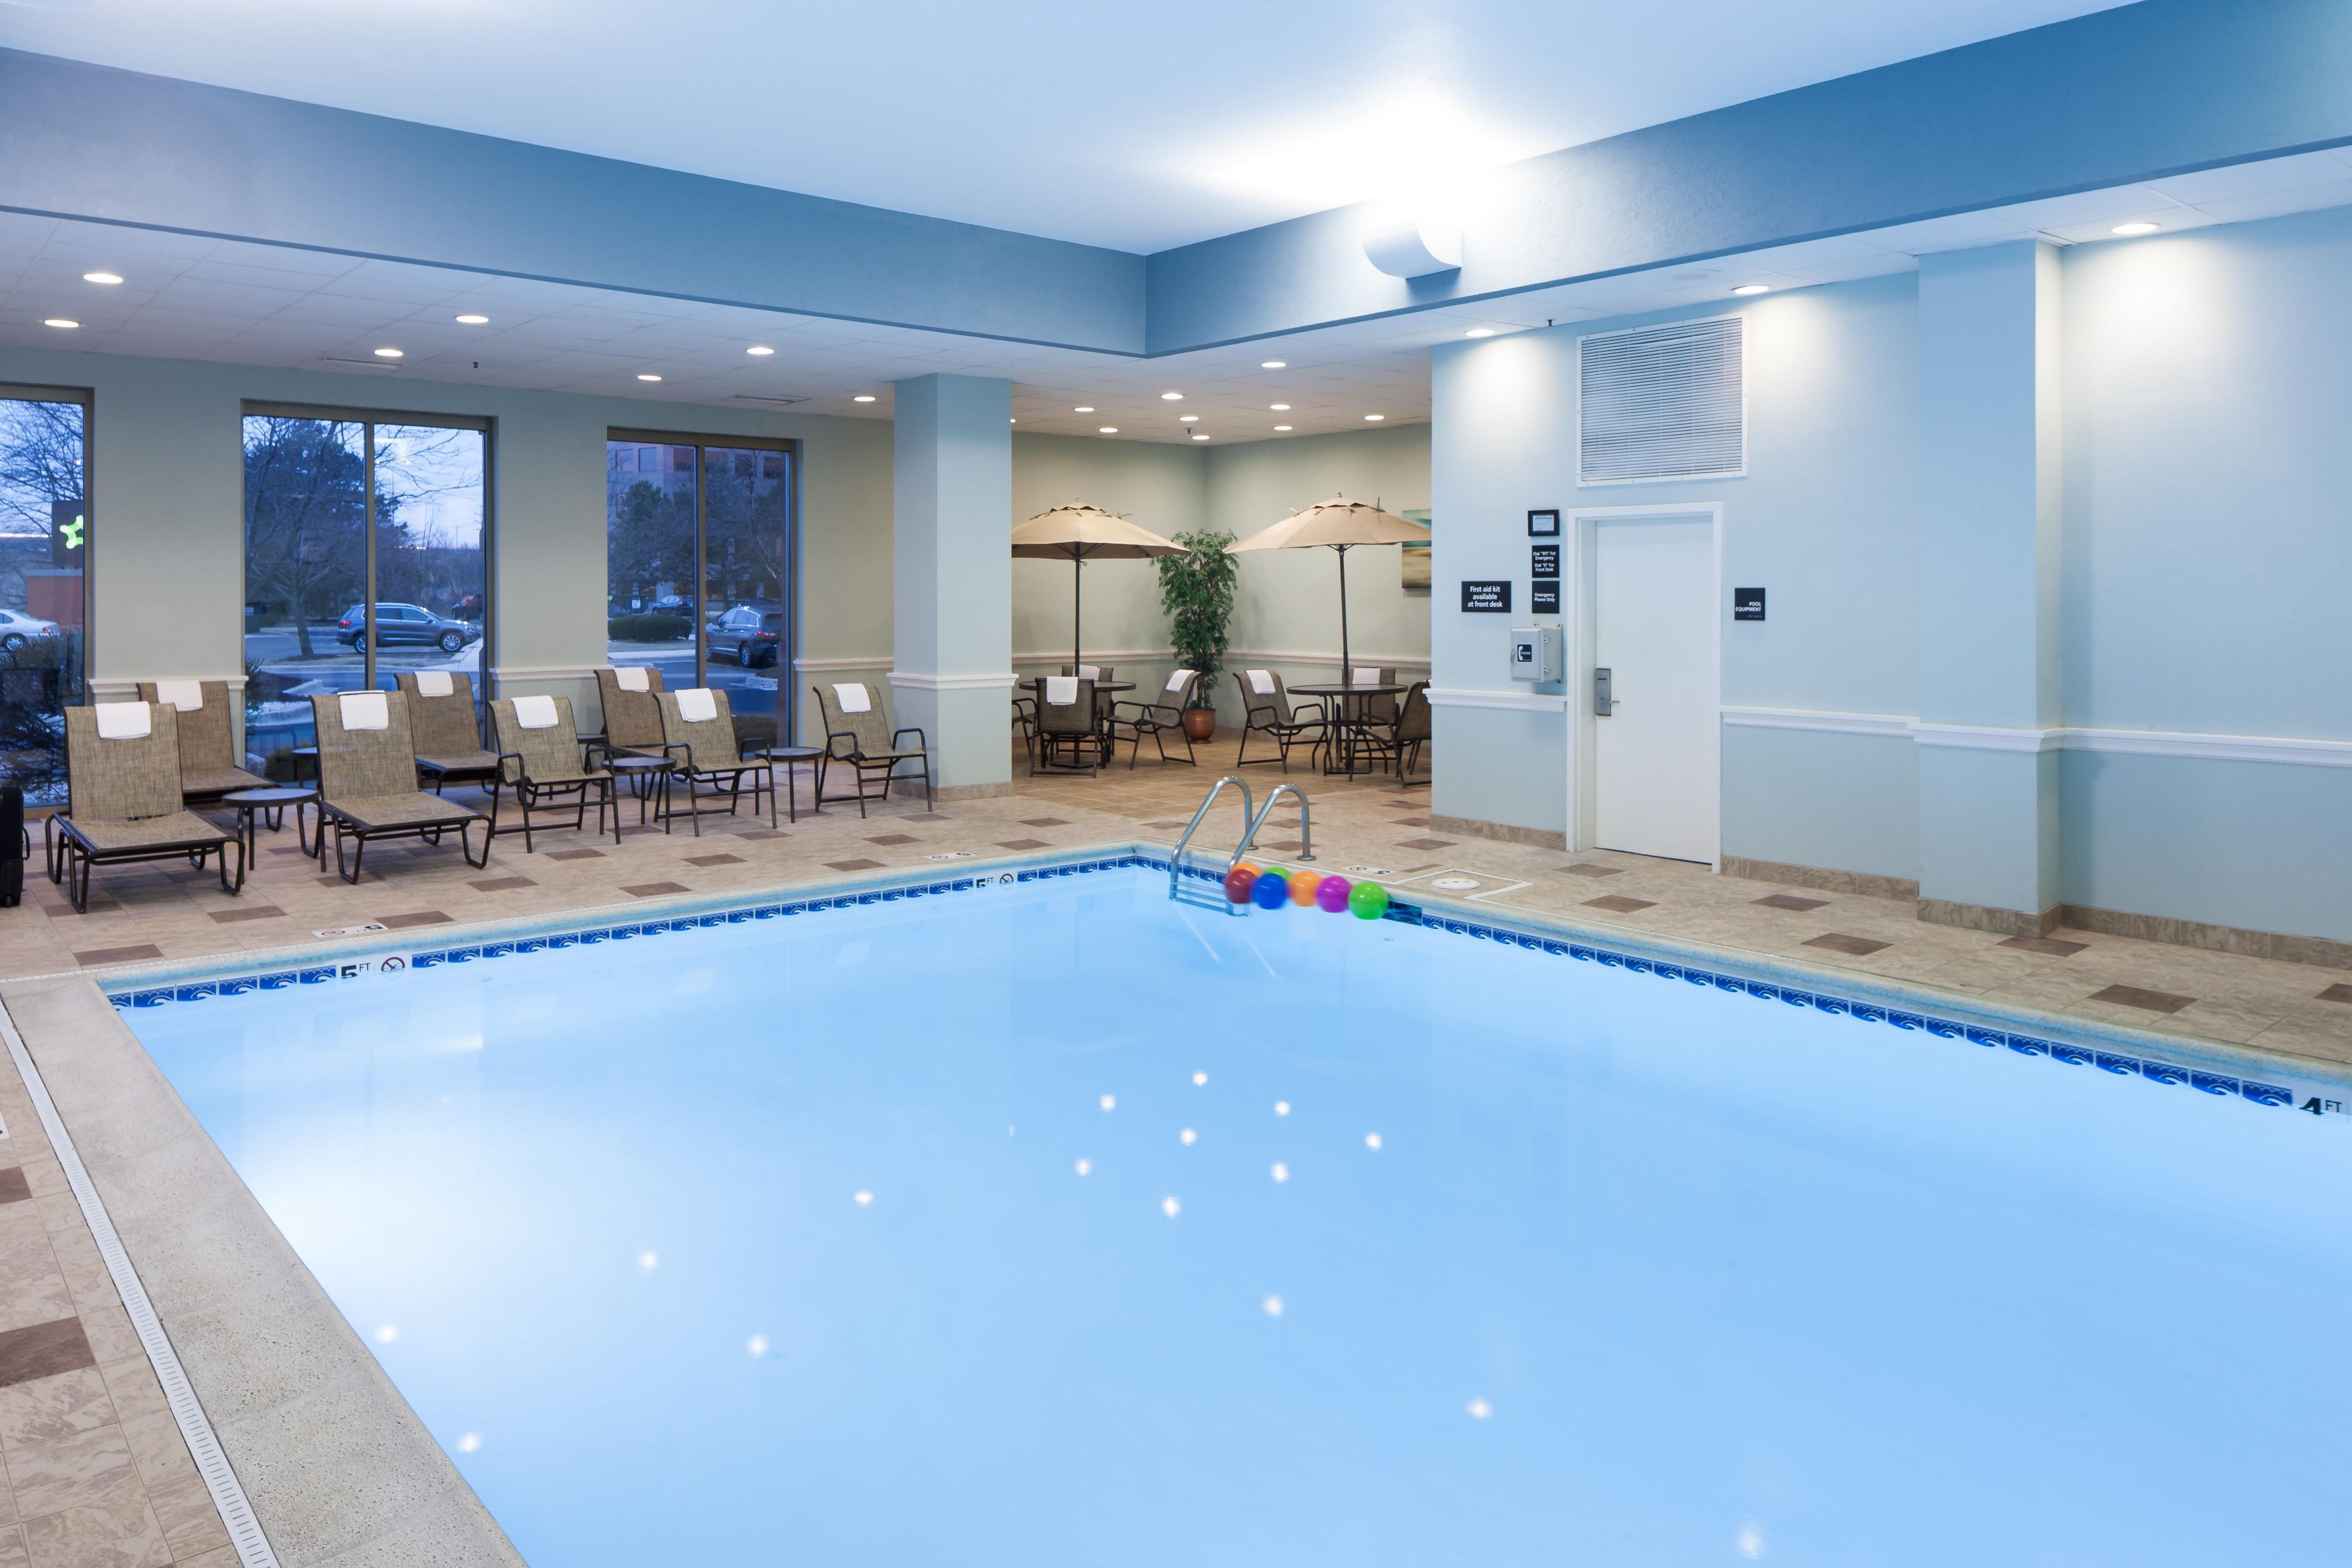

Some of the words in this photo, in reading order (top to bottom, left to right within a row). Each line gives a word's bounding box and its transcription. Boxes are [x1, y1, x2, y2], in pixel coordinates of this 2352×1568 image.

[976, 878, 986, 888] 5
[341, 965, 358, 979] 5
[360, 963, 371, 972] FT
[2299, 1097, 2324, 1115] 4
[2326, 1100, 2342, 1112] FT
